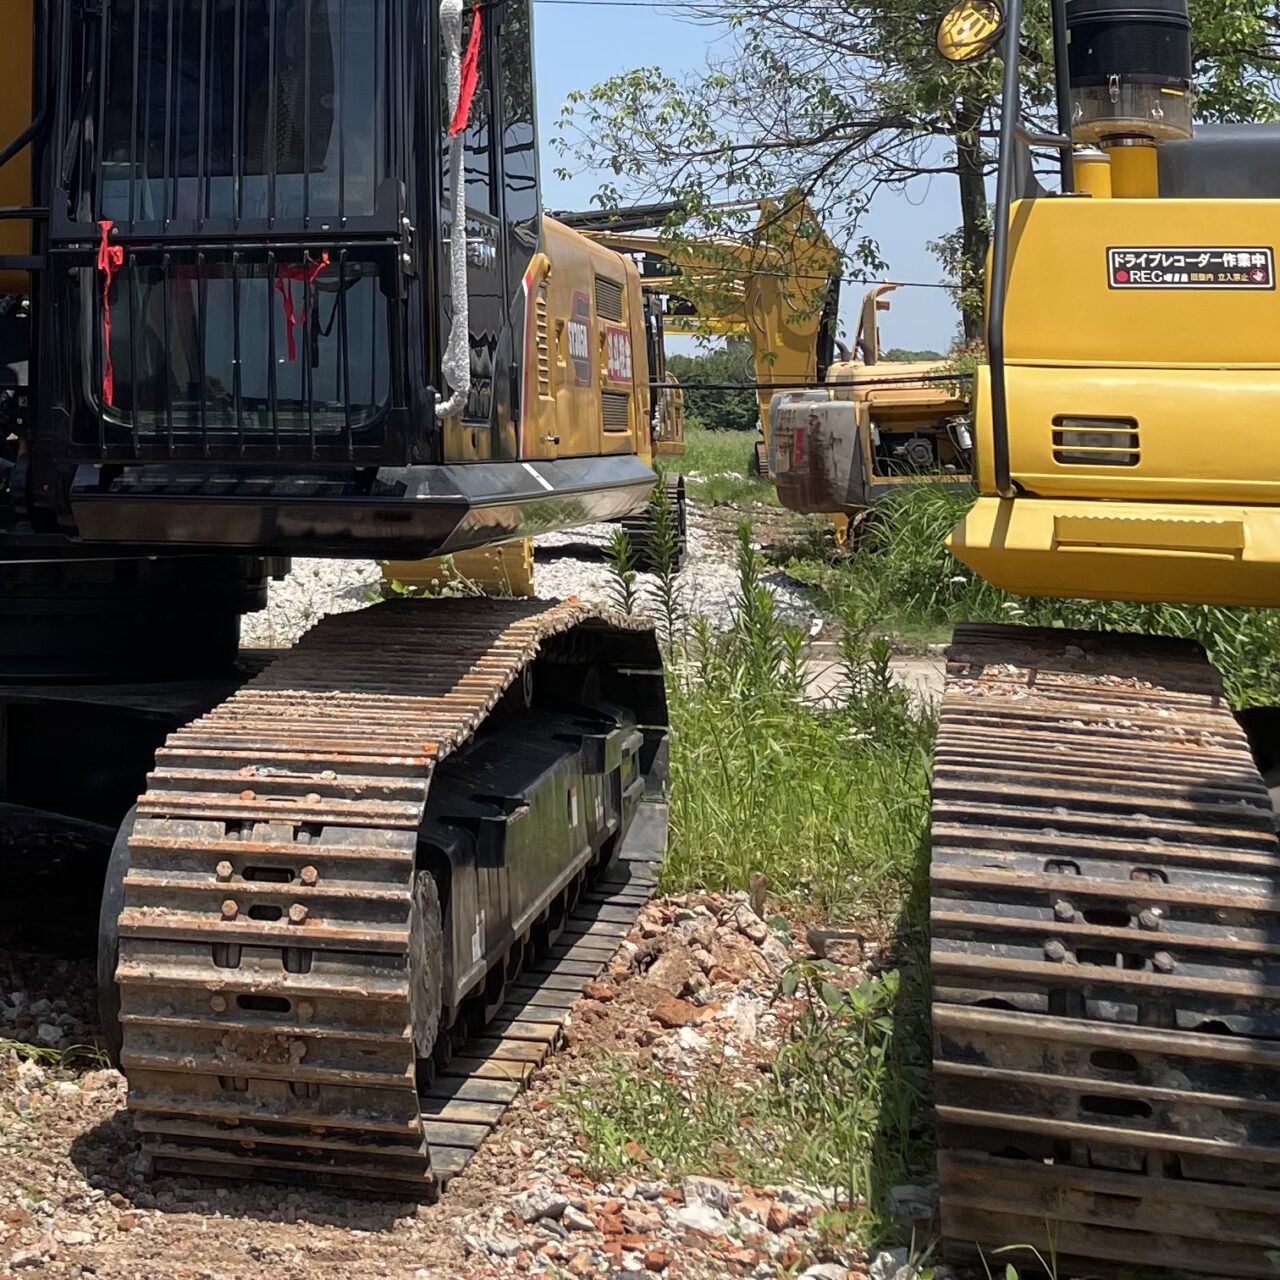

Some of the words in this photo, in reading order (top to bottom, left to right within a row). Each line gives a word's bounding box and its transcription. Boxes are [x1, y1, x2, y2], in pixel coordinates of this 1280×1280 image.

[1113, 253, 1266, 268] ドライブレコーダー作業中
[1130, 270, 1163, 283] REC
